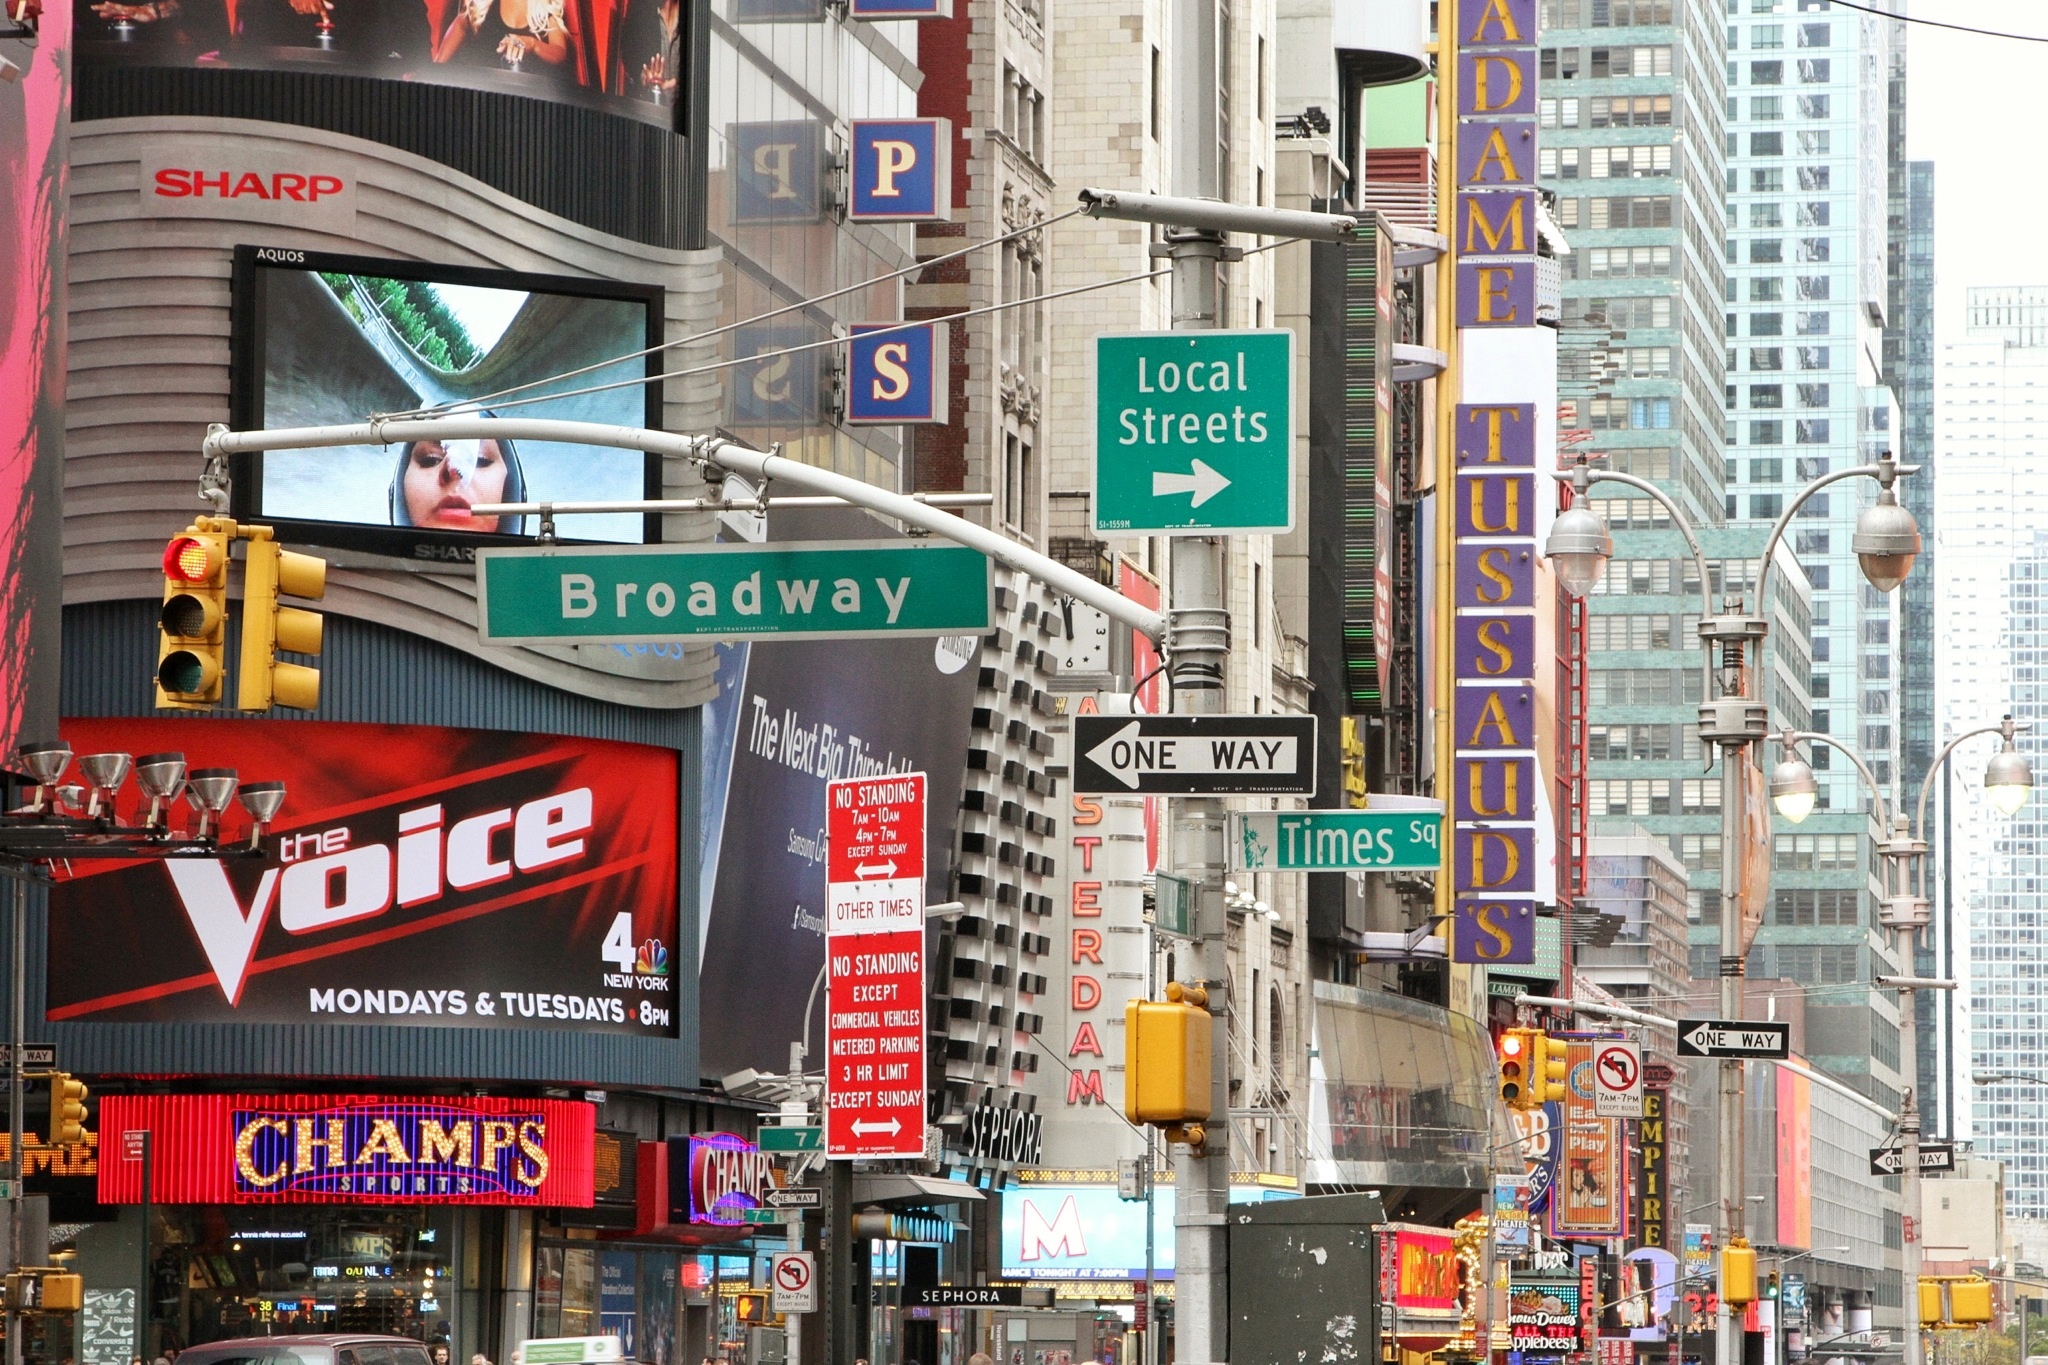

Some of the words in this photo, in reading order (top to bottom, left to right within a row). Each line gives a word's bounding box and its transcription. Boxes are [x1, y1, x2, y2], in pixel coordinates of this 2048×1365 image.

[155, 169, 343, 201] SHARP
[256, 248, 304, 263] AQUOS
[1139, 352, 1247, 393] Local
[1119, 406, 1268, 445] Streets
[414, 544, 476, 561] SHAR
[560, 571, 911, 624] Broadway
[1467, 407, 1521, 959] TUSSAUD'S
[750, 694, 779, 761] The
[779, 708, 818, 775] Next
[1111, 740, 1176, 770] ONE
[1211, 740, 1282, 770] WAY
[836, 787, 852, 808] NO
[858, 781, 915, 807] STANDING
[279, 826, 350, 860] the
[847, 844, 874, 858] EXCEPT
[878, 842, 907, 856] SUNDAY
[1280, 821, 1395, 865] Times
[1409, 819, 1437, 850] Sq
[837, 901, 874, 920] OTHER
[879, 899, 913, 917] TIMES
[1067, 697, 1104, 1105] ASTERDAM
[602, 912, 636, 973] 4
[833, 955, 850, 977] NO
[855, 952, 919, 976] STANDING
[604, 973, 633, 989] NEW
[635, 975, 668, 991] YORK
[853, 984, 898, 1002] EXCEPT
[310, 988, 468, 1015] MONDAYS
[474, 992, 496, 1016] &
[500, 992, 625, 1023] TUESDAYS
[639, 1000, 669, 1027] 8PM
[832, 1011, 880, 1029] COMMERCIAL
[884, 1009, 920, 1026] VEHICLES
[833, 1037, 875, 1055] METERED
[880, 1036, 919, 1053] PARKING
[1695, 1031, 1727, 1046] ONE
[1742, 1033, 1775, 1048] WAY
[27, 1052, 49, 1060] WAY
[843, 1065, 850, 1081] 3
[857, 1065, 873, 1081] HR
[879, 1063, 909, 1080] LIMIT
[830, 1091, 872, 1109] EXCEPT
[877, 1089, 921, 1107] SUNDAY
[1621, 1104, 1640, 1112] BUSES
[1569, 1105, 1596, 1119] Ea
[794, 1132, 807, 1147] 7
[969, 1103, 1044, 1165] SEPHORA
[235, 1117, 548, 1187] CHAMPS
[1569, 1136, 1607, 1154] Play
[1885, 1154, 1902, 1167] ON
[702, 1146, 776, 1215] CHAMPS
[1640, 1095, 1664, 1247] EMPIRE
[340, 1176, 470, 1193] SPORTS
[771, 1194, 788, 1203] ONE
[795, 1194, 814, 1203] WAY
[1497, 1201, 1515, 1210] NEW
[752, 1210, 761, 1222] 7
[1497, 1220, 1528, 1228] THEATER
[1033, 1268, 1078, 1277] TONIGHT
[1079, 1268, 1092, 1277] AT
[922, 1290, 1000, 1302] SEPHORA
[277, 1302, 297, 1311] Final
